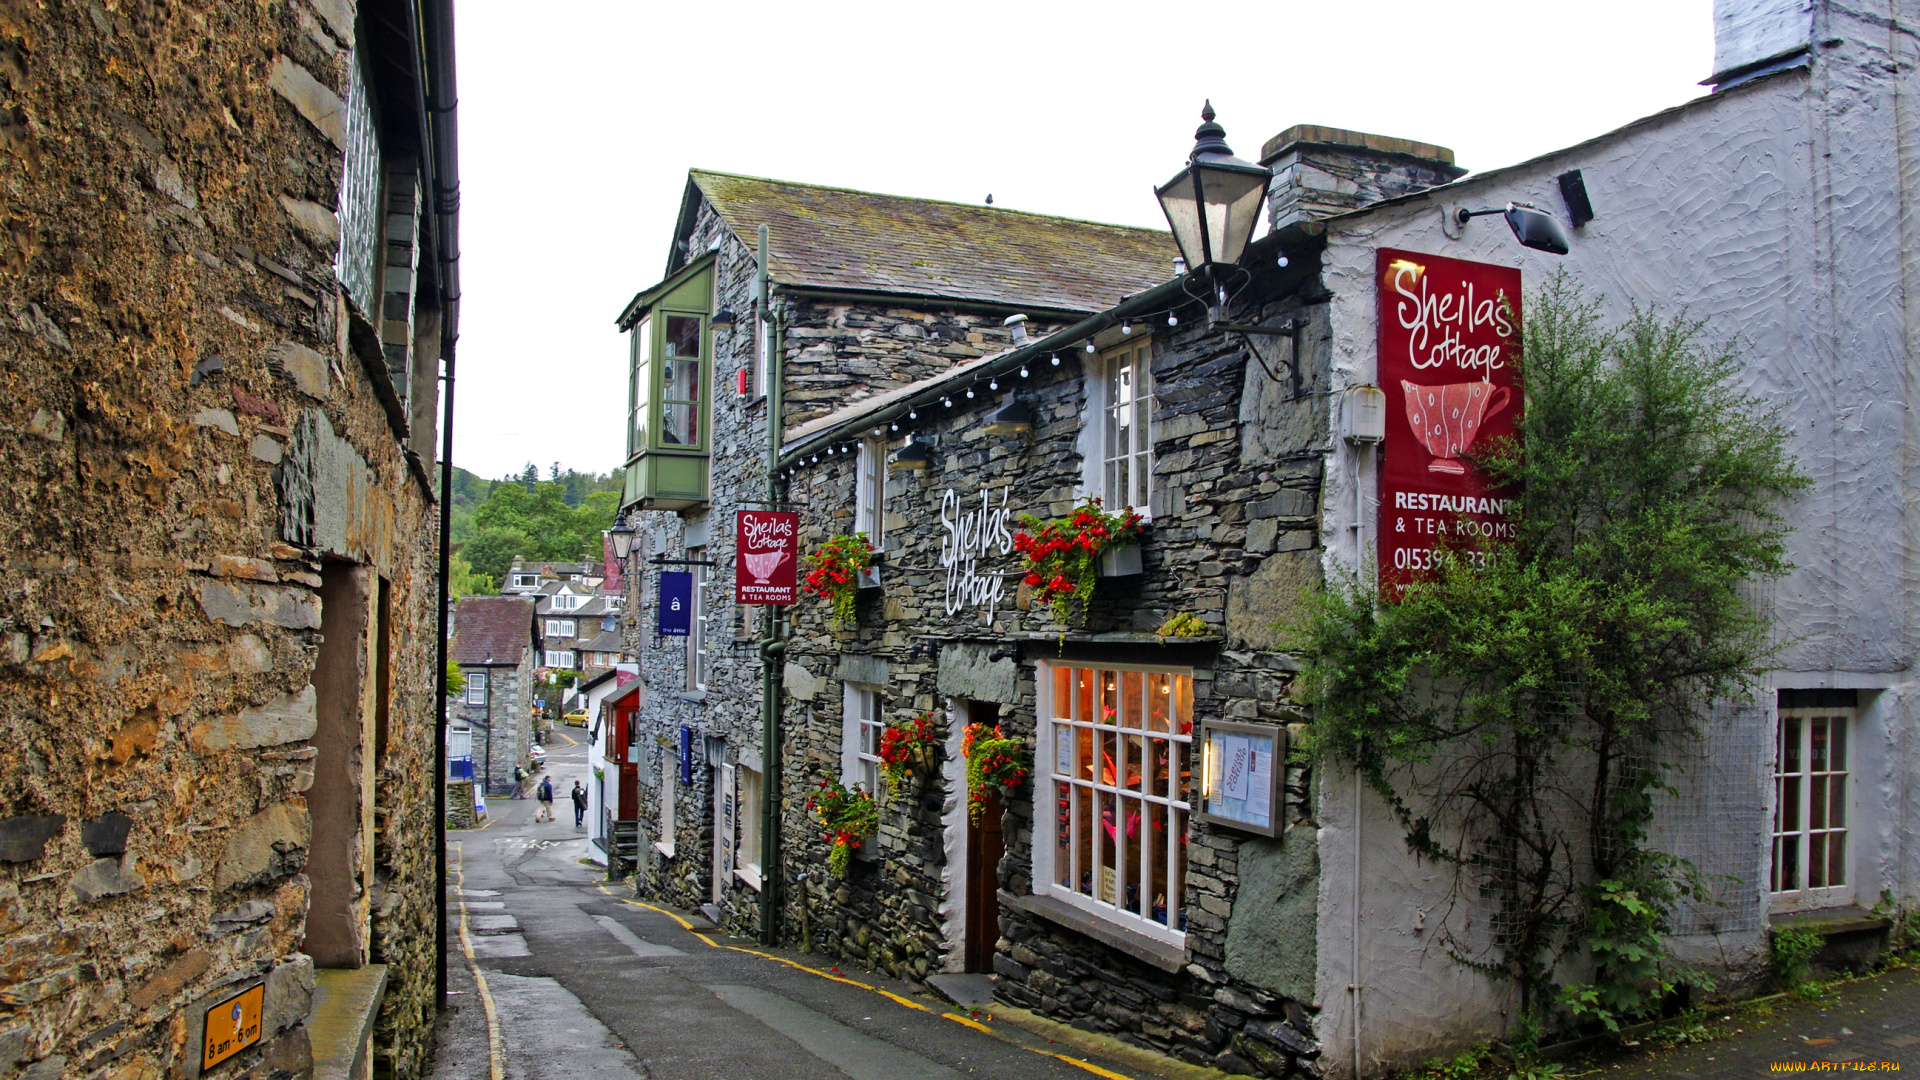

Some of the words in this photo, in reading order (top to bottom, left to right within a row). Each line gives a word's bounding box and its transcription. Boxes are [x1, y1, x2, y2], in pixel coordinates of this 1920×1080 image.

[1395, 267, 1512, 337] Sheila's
[1409, 321, 1505, 385] Cottage
[743, 514, 792, 537] Sheila's
[941, 485, 1013, 568] Sheila's
[1395, 517, 1406, 533] &
[1414, 517, 1447, 535] TEA
[1456, 520, 1516, 539] ROOMS
[748, 533, 789, 553] Cottage
[741, 585, 791, 593] RESTAURANT
[945, 554, 1005, 626] Cottage
[208, 1043, 215, 1059] 8
[217, 1039, 230, 1054] am
[237, 1028, 243, 1043] 6
